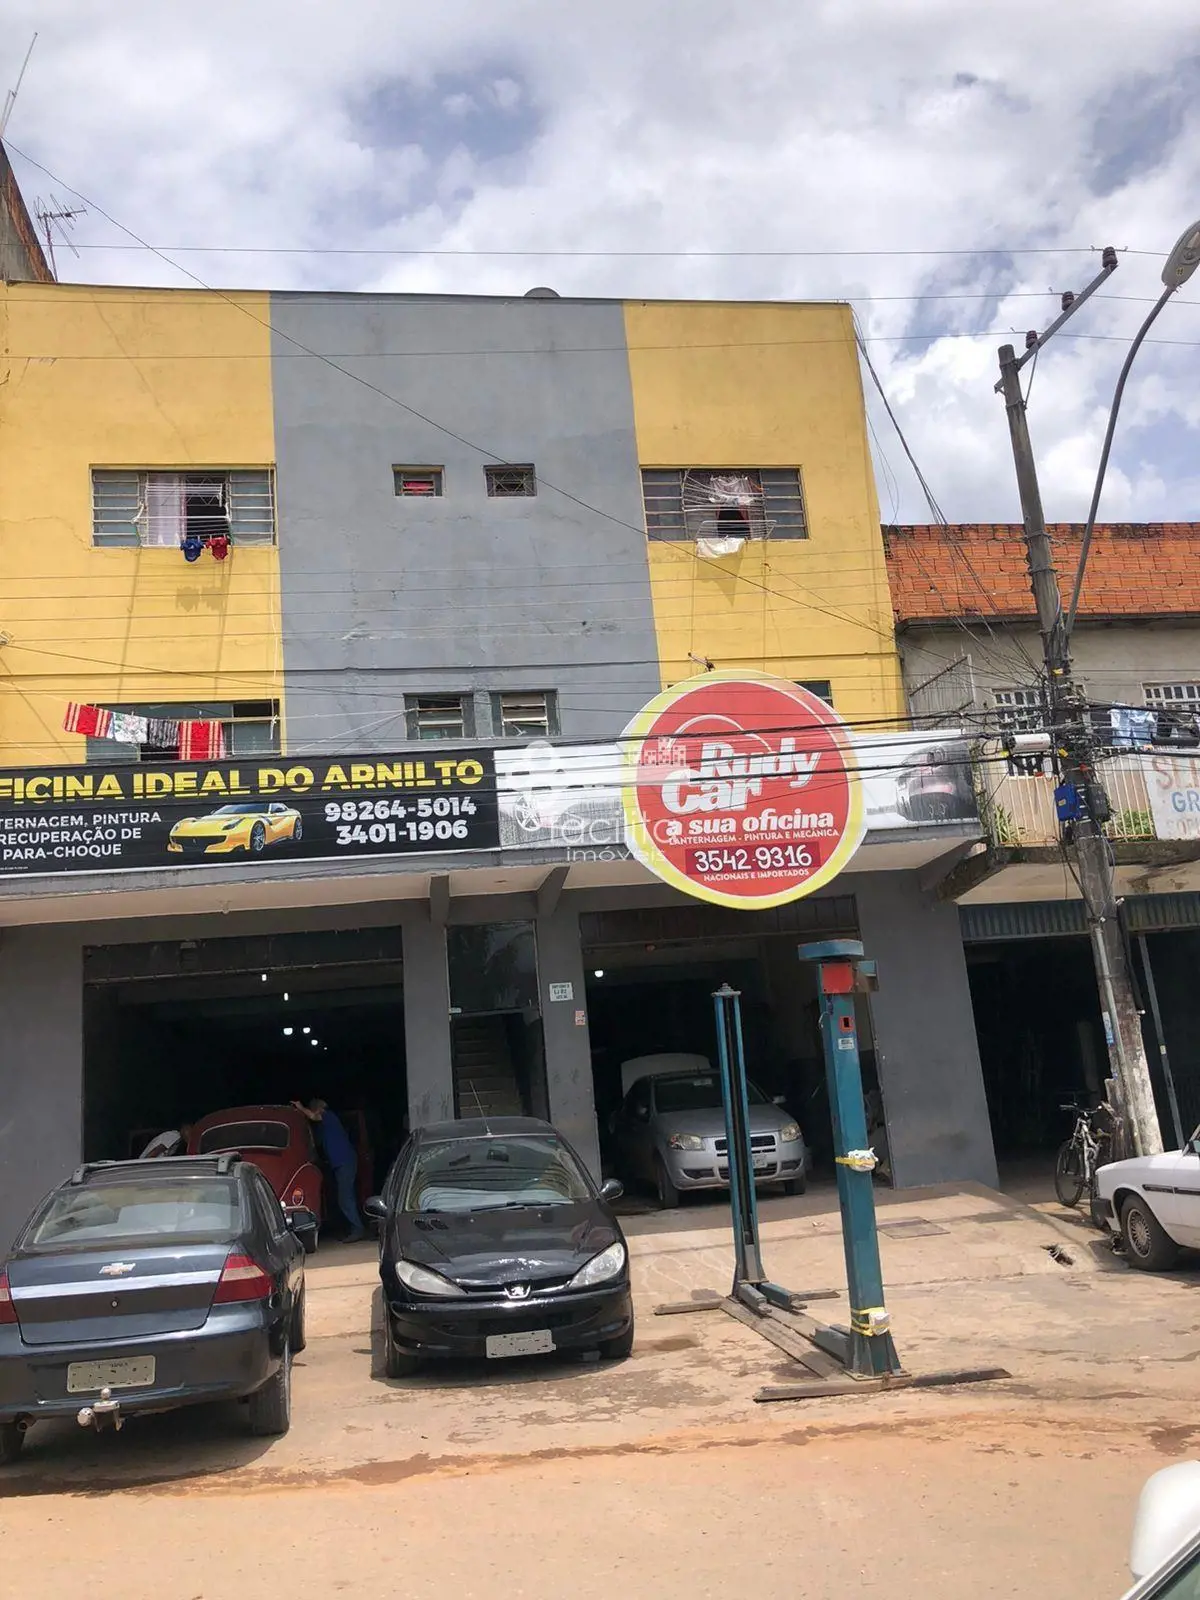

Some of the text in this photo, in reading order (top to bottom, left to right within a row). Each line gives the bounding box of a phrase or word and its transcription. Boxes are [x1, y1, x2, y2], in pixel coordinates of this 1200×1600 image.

[701, 737, 821, 788] Rudy
[133, 769, 250, 799] IDEAL
[258, 765, 315, 793] DO
[321, 759, 484, 791] ARNILTO
[661, 768, 762, 815] Car
[0, 811, 161, 830] ERNAGEM, PINTURA
[324, 797, 477, 822] 98264-5014
[666, 808, 834, 836] a sua oficina
[121, 827, 142, 839] DE
[336, 819, 469, 845] 3401-1906
[744, 832, 783, 842] PINTURA
[3, 843, 122, 861] PARA-CHOQUE
[694, 844, 812, 872] 3542-9316
[703, 871, 749, 882] NACIONAIS
[757, 868, 810, 879] IMPORTADOS
